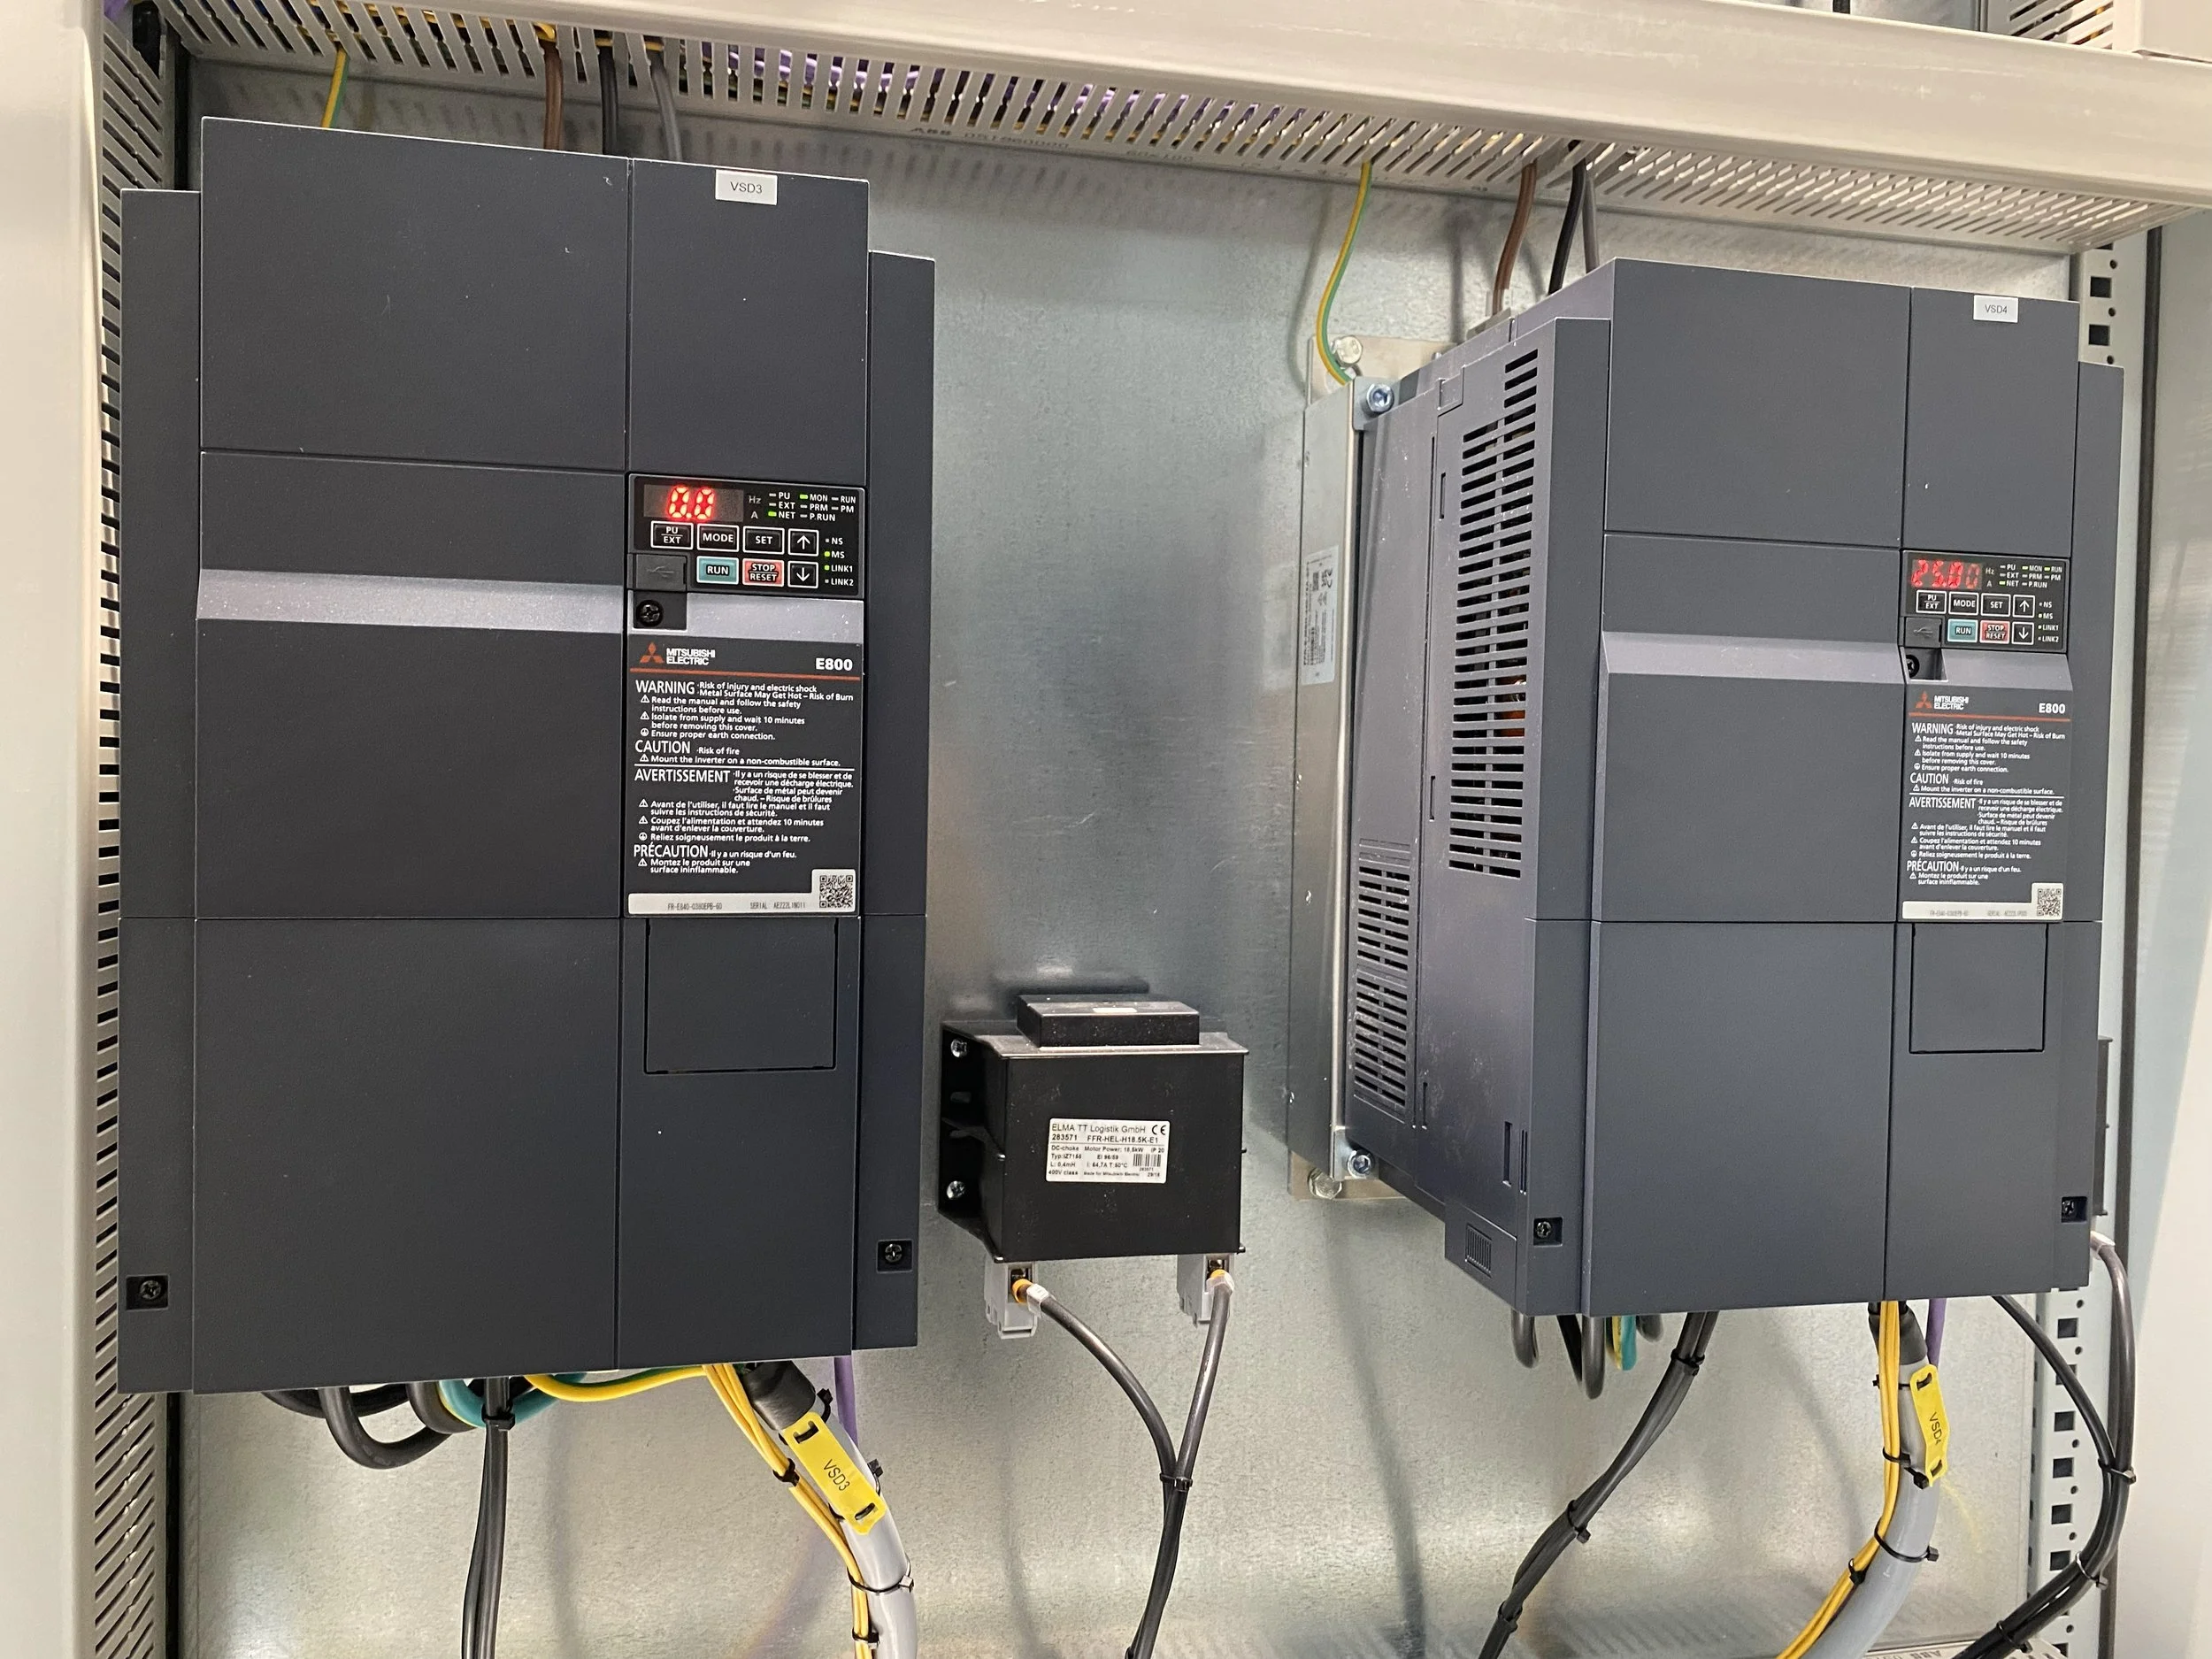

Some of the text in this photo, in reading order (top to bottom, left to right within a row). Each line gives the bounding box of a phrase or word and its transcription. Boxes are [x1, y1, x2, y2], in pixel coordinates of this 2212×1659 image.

[730, 181, 763, 194] VSD3
[1985, 304, 2008, 314] VSD4
[668, 486, 715, 520] 0.0
[749, 495, 761, 504] Hz
[810, 513, 835, 522] P.RUN
[703, 533, 733, 542] MODE
[756, 536, 772, 545] SET
[707, 565, 729, 575] RUN
[752, 563, 775, 572] STOP
[666, 648, 716, 658] MITSUBISHI
[666, 657, 709, 665] ELECTRIC
[816, 657, 853, 671] E800
[635, 680, 695, 695] WARNING
[726, 682, 749, 692] injury
[754, 691, 771, 700] May
[652, 704, 697, 713] instructions
[778, 700, 801, 709] safety
[2039, 703, 2066, 714] E800
[700, 714, 726, 724] supply
[680, 722, 717, 731] removing
[1912, 722, 1954, 734] WARNING
[651, 729, 677, 738] Ensure
[634, 739, 690, 754] CAUTION
[698, 746, 714, 755] Risk
[634, 768, 731, 783] AVERTISSEMENT
[1909, 772, 1948, 784] CAUTION
[1909, 796, 1976, 809] AVERTISSEMENT
[650, 817, 680, 826] Coupez
[675, 833, 734, 842] soigneusement
[634, 841, 709, 857] PRÉCAUTION
[1907, 858, 1959, 872] PRÉCAUTION
[1090, 1125, 1118, 1133] Logistik
[824, 1458, 850, 1491] VSD3
